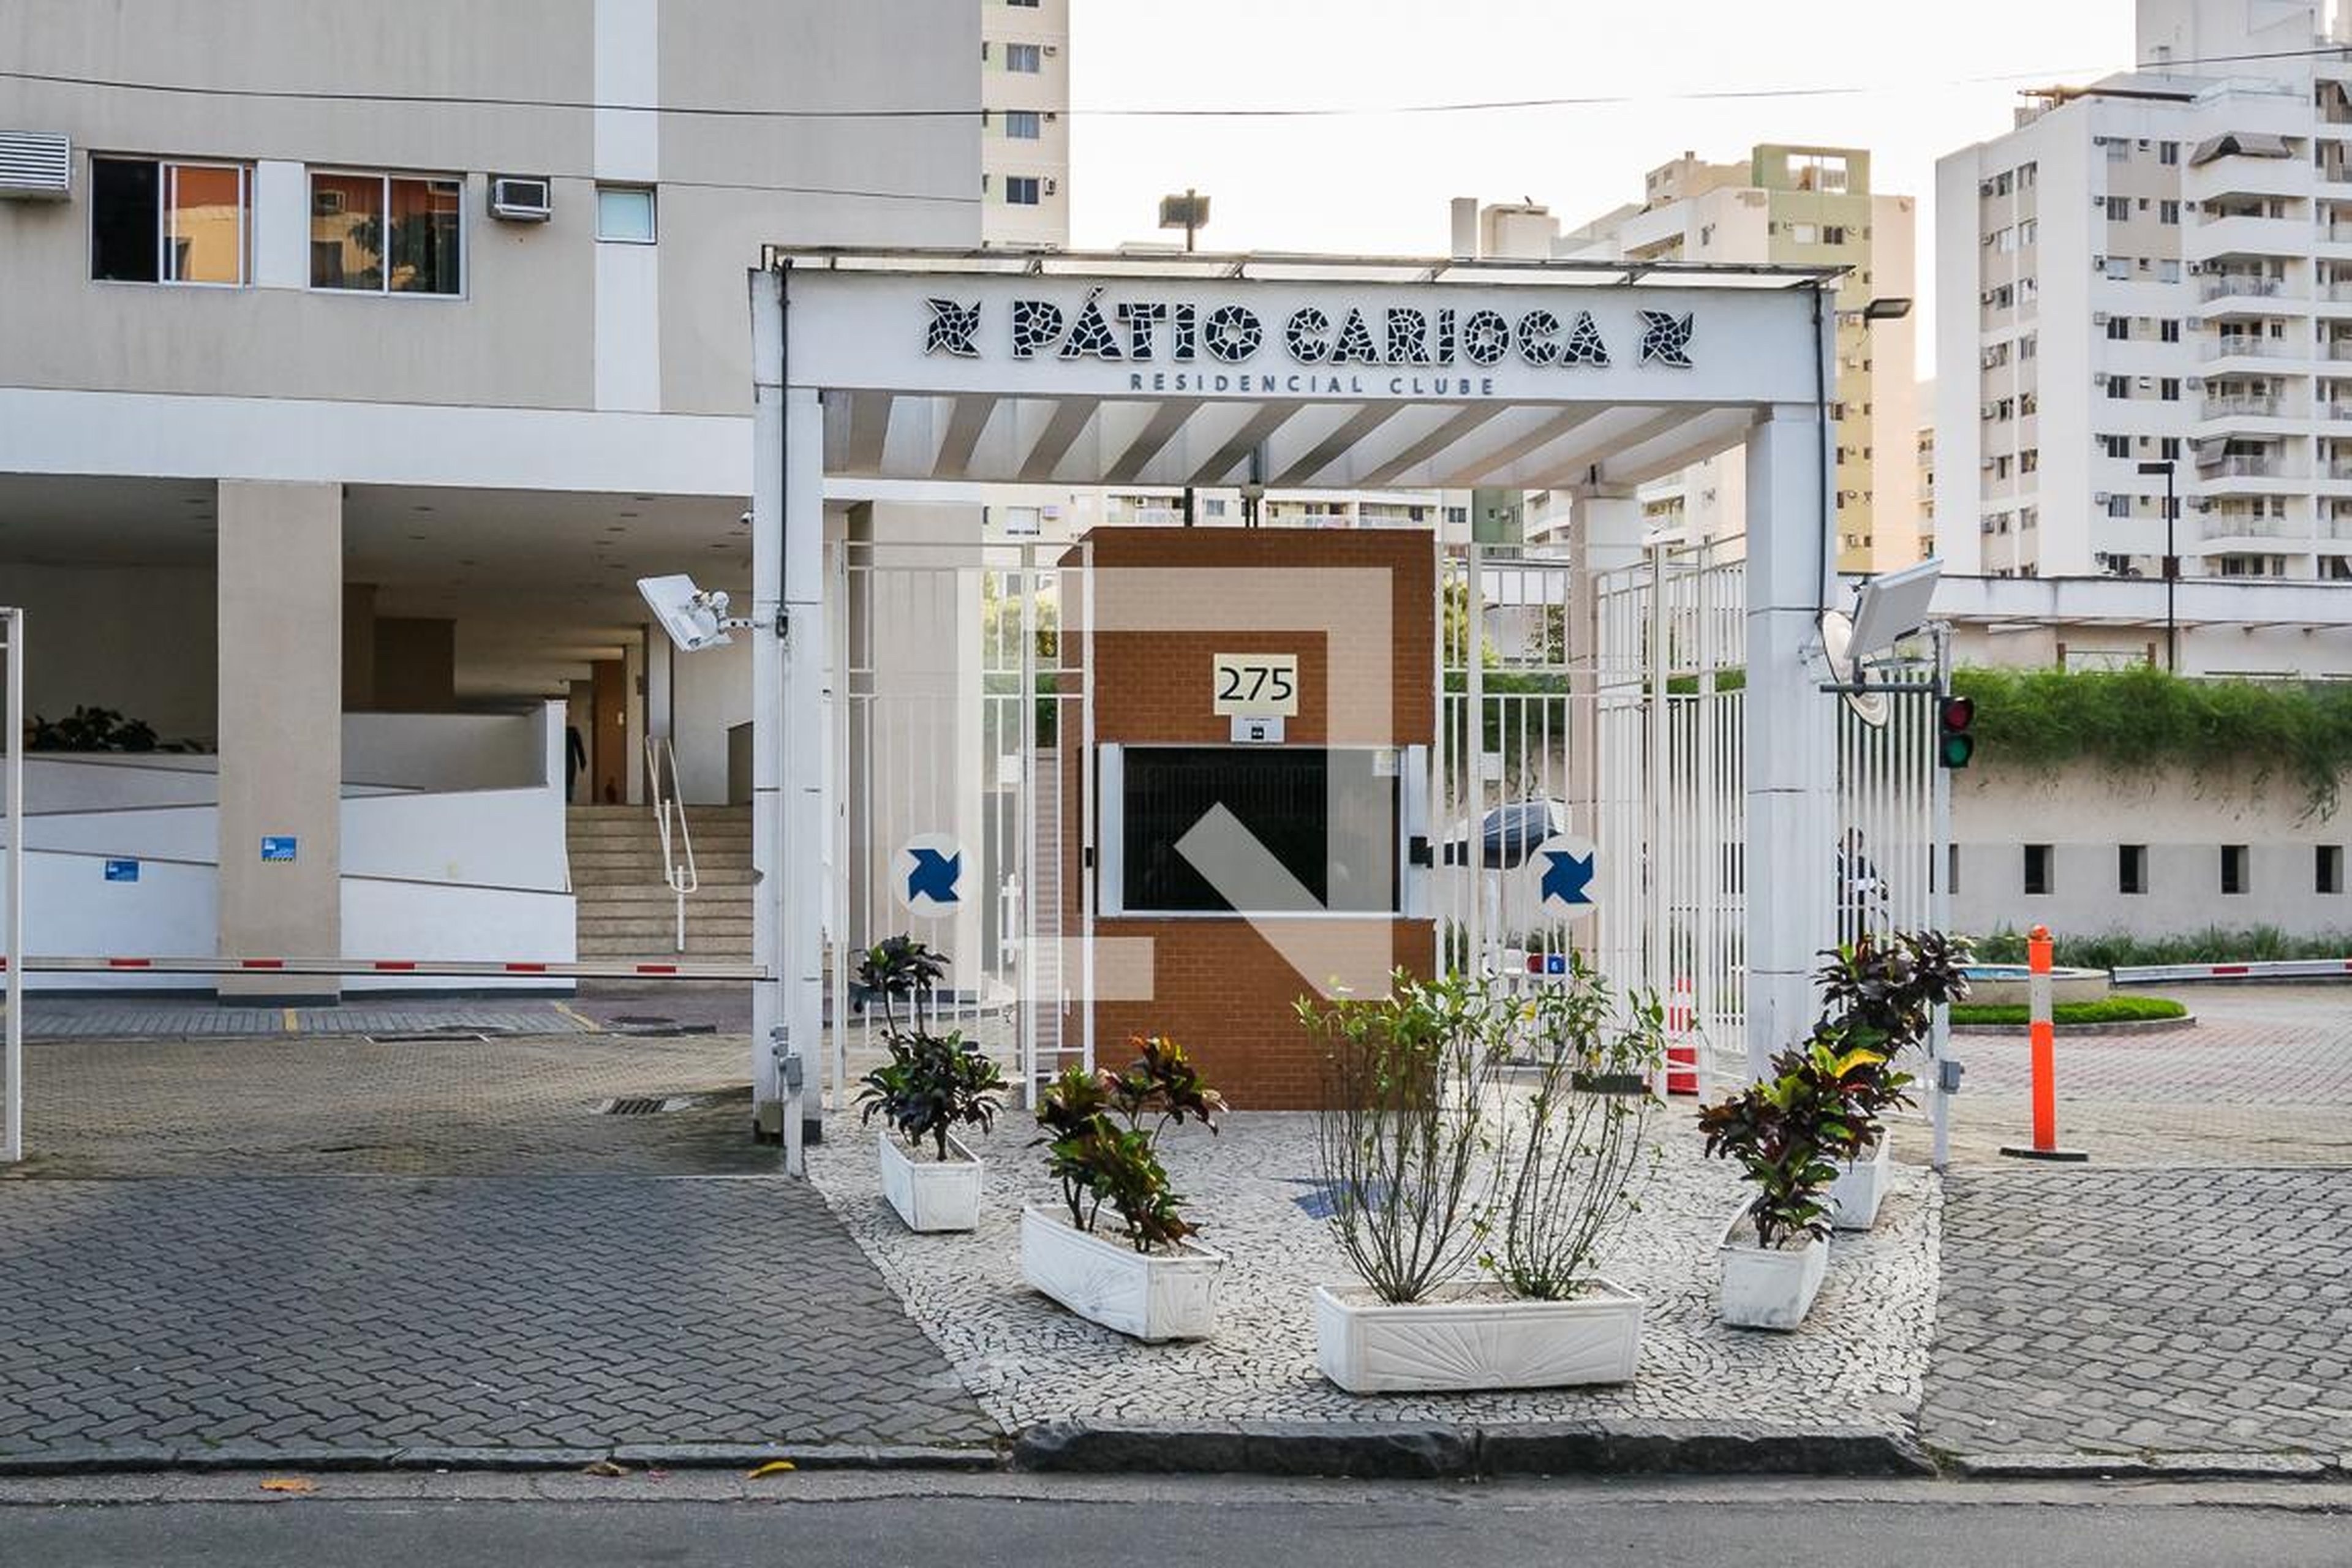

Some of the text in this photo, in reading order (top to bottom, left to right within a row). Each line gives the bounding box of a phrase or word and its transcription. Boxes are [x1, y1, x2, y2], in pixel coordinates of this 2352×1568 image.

[1012, 287, 1611, 366] PÁTIO CARIOCA
[1130, 373, 1493, 395] RESIDENCIAL CLUBE
[1219, 667, 1292, 701] 275
